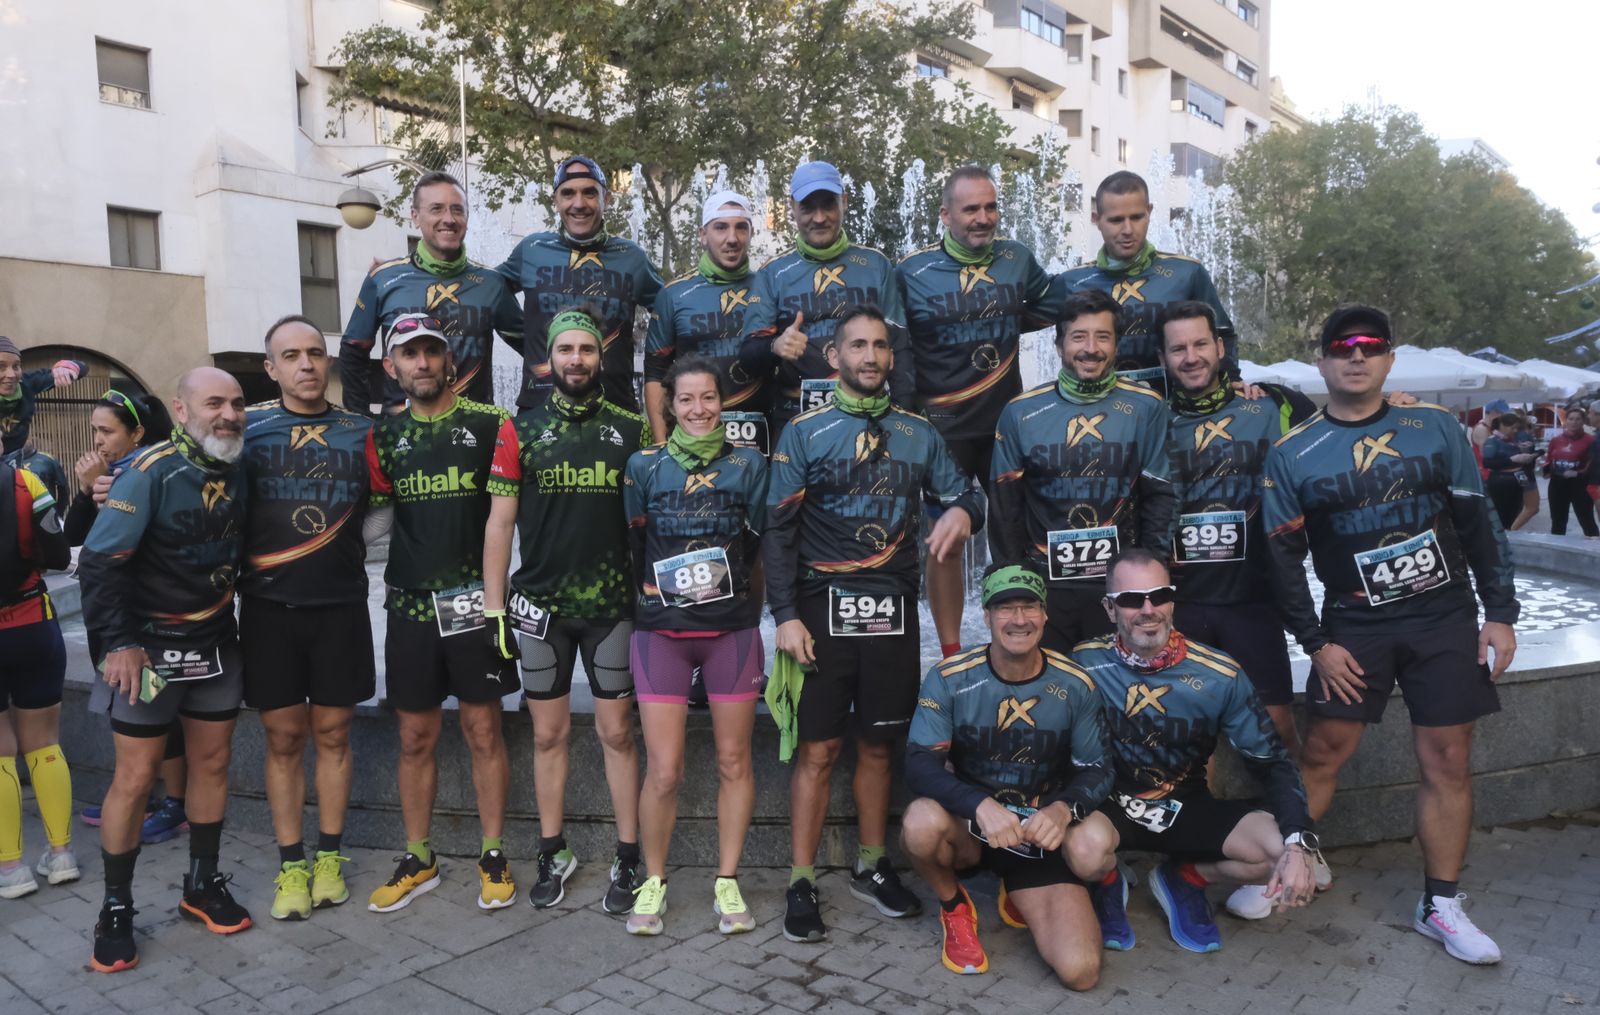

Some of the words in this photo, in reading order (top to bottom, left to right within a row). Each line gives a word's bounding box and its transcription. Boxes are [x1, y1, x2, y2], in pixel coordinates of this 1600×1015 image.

[849, 254, 869, 267] SIG
[1154, 265, 1174, 278] SIG
[812, 264, 846, 297] IX
[958, 264, 996, 297] IX
[1112, 278, 1148, 305] IX
[426, 282, 462, 311] IX
[719, 287, 750, 315] IX
[979, 300, 1005, 320] las
[1113, 400, 1134, 415] SIG
[726, 421, 756, 440] 80
[895, 421, 914, 436] SIG
[1066, 411, 1107, 449] IX
[1194, 415, 1235, 455] IX
[1398, 417, 1425, 429] SIG
[289, 424, 329, 451] IX
[728, 454, 748, 467] SIG
[1351, 429, 1402, 475] IX
[306, 462, 334, 478] las
[1081, 458, 1105, 477] las
[683, 471, 721, 496] IX
[869, 477, 894, 495] las
[1383, 477, 1416, 502] las
[201, 480, 233, 513] IX
[1181, 524, 1238, 546] 395
[1057, 539, 1112, 563] 372
[674, 562, 713, 589] 88
[1372, 548, 1436, 584] 429
[838, 596, 895, 618] 594
[1045, 682, 1068, 700] SIG
[1179, 673, 1205, 690] SIG
[1125, 681, 1173, 718] IX
[997, 695, 1040, 732] IX
[1012, 746, 1037, 765] las
